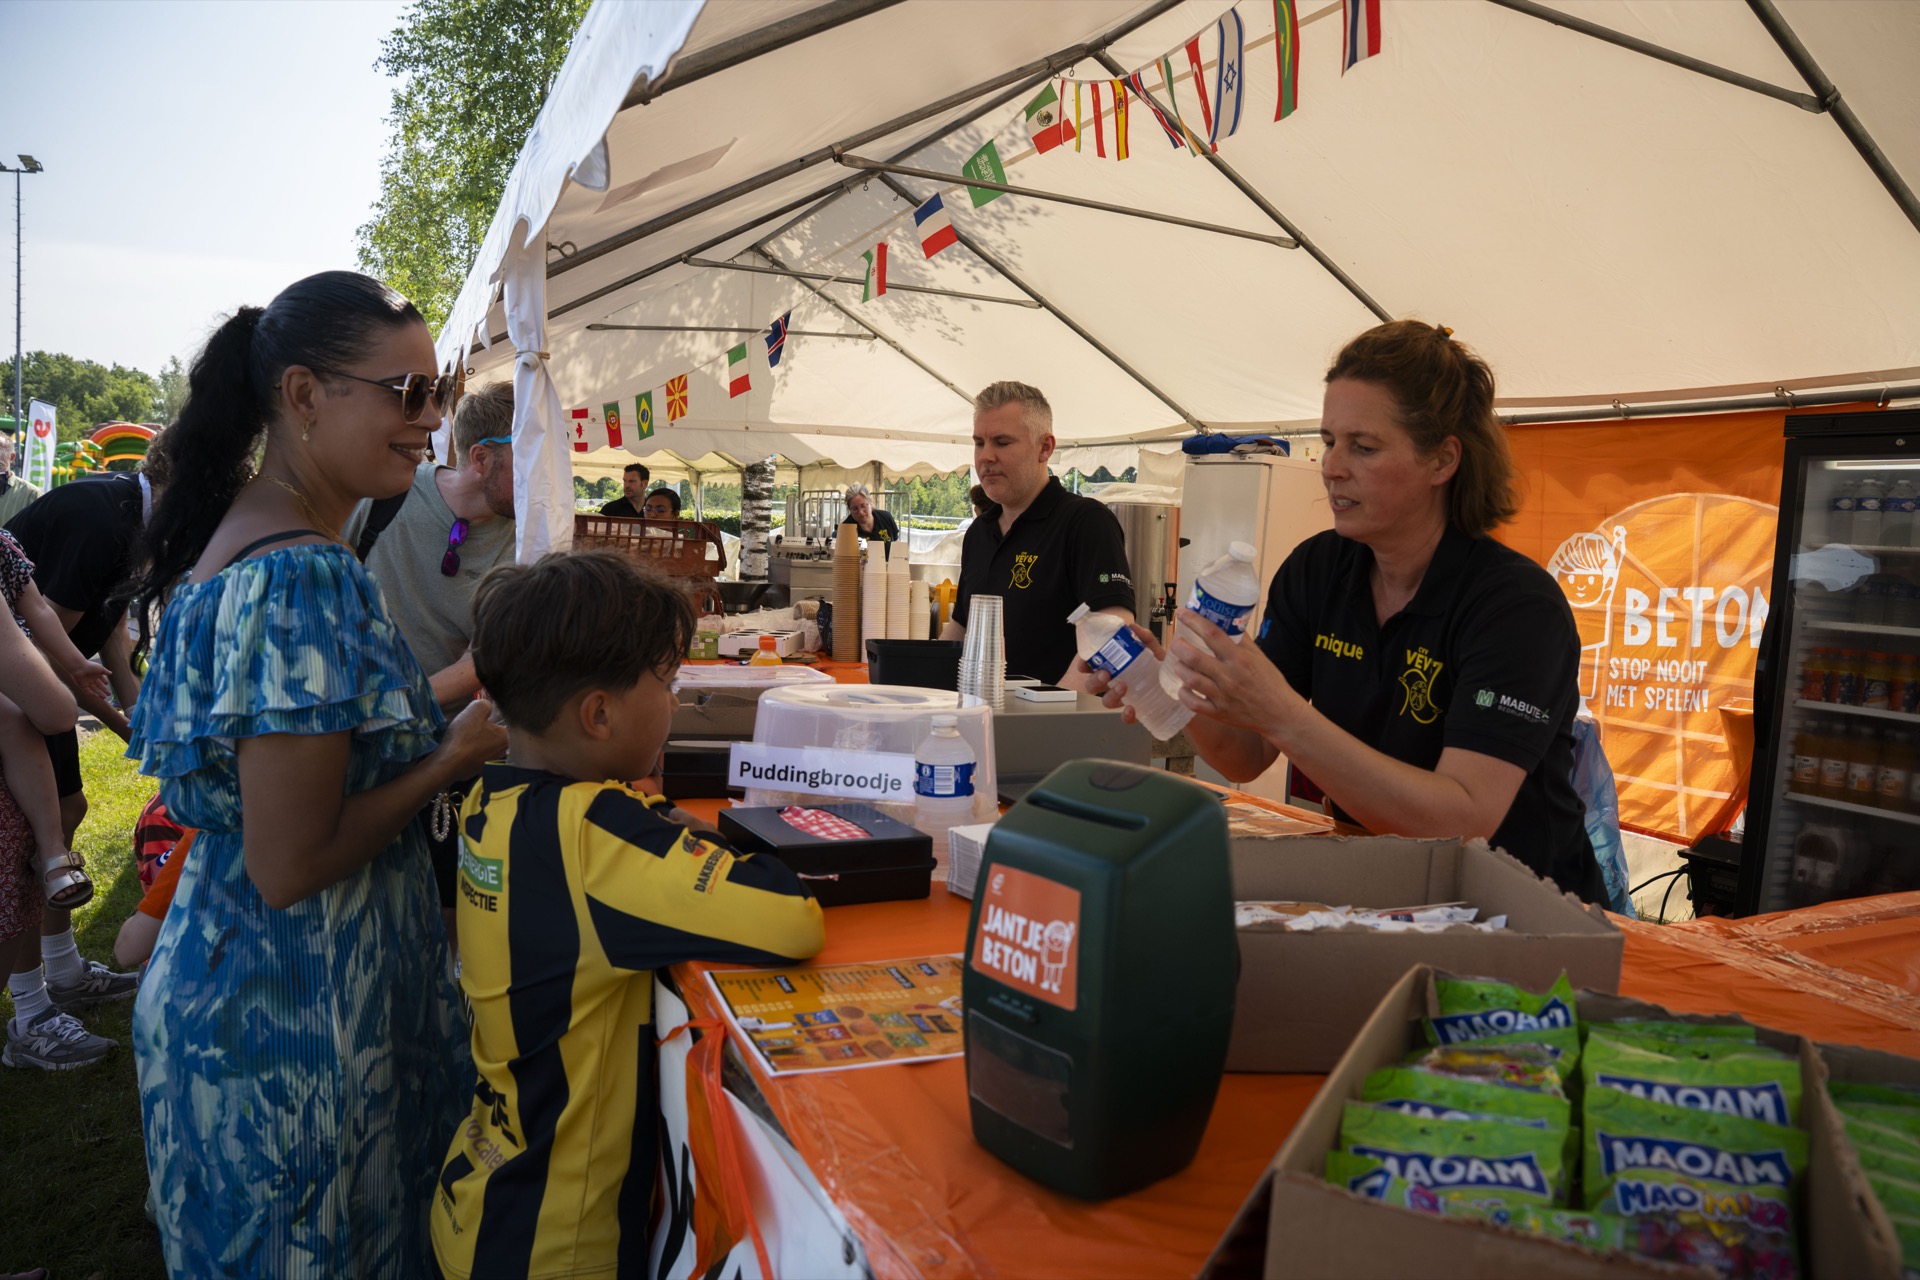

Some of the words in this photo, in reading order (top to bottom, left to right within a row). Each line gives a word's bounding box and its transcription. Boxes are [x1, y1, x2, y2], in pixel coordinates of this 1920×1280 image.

[1201, 597, 1237, 617] LOUISE
[1315, 633, 1364, 660] nique
[1609, 657, 1650, 680] STOP
[1656, 660, 1708, 683] NOOIT
[1606, 685, 1637, 708] MET
[1644, 687, 1709, 712] SPELEN!
[739, 761, 902, 794] Puddingbroodje
[982, 904, 1045, 951] JANTJE
[982, 936, 1037, 985] BETON
[1612, 1140, 1786, 1184] MAOAM
